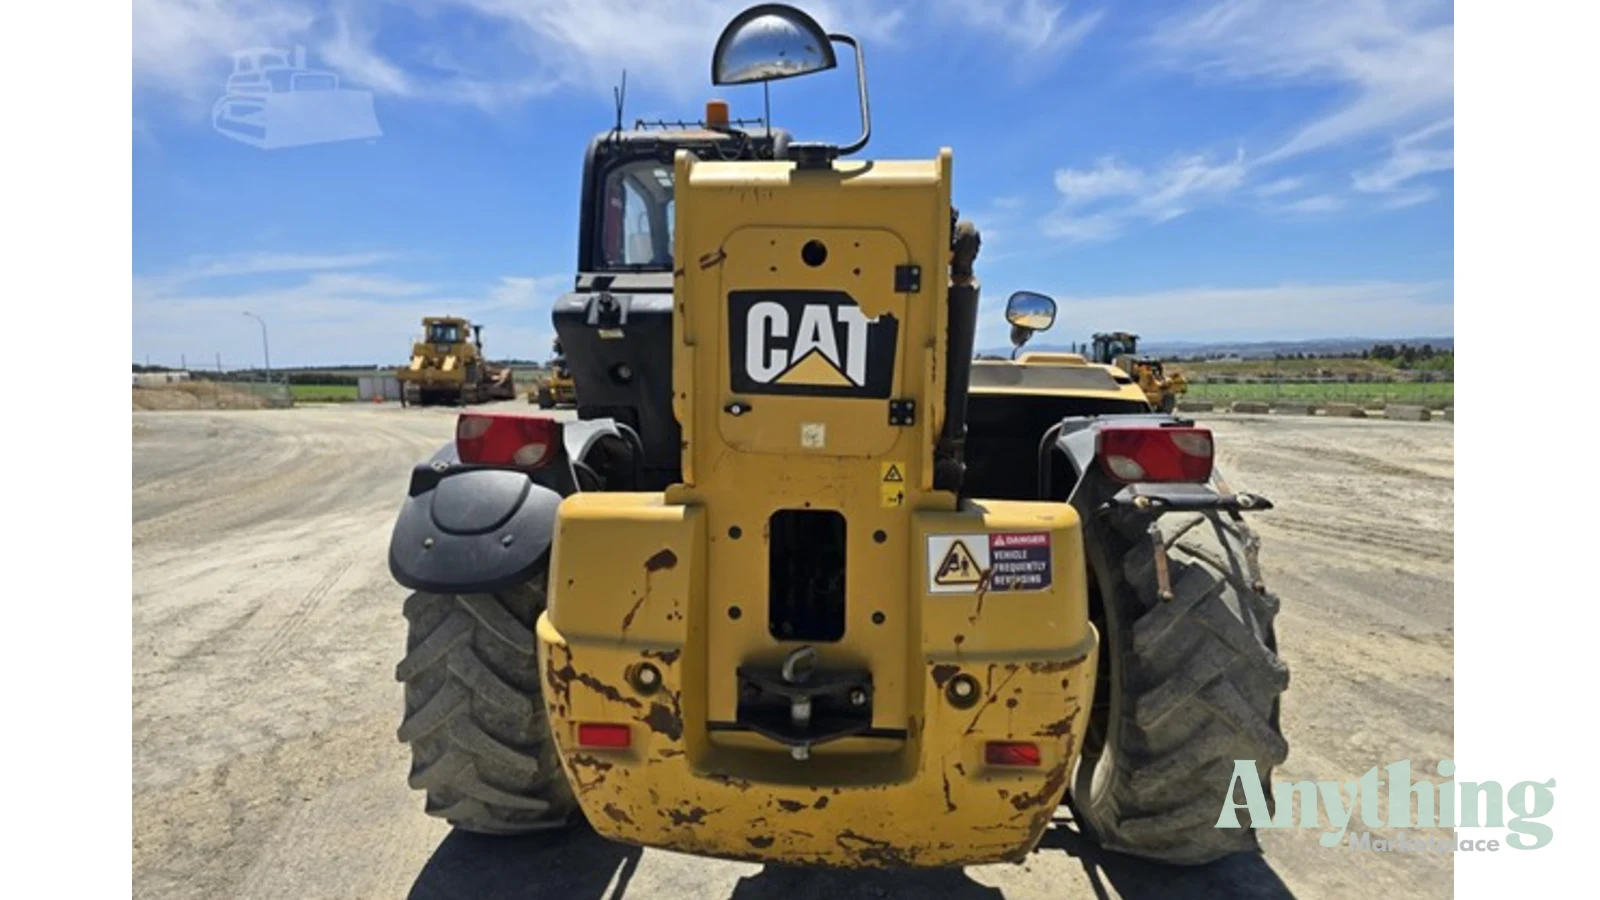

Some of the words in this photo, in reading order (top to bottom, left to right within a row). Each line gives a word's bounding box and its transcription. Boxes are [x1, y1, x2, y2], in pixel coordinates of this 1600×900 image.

[746, 301, 879, 387] CAT
[1005, 535, 1046, 545] DANGER
[993, 550, 1028, 560] VEHICLE
[993, 561, 1046, 573] FREQUENTLY
